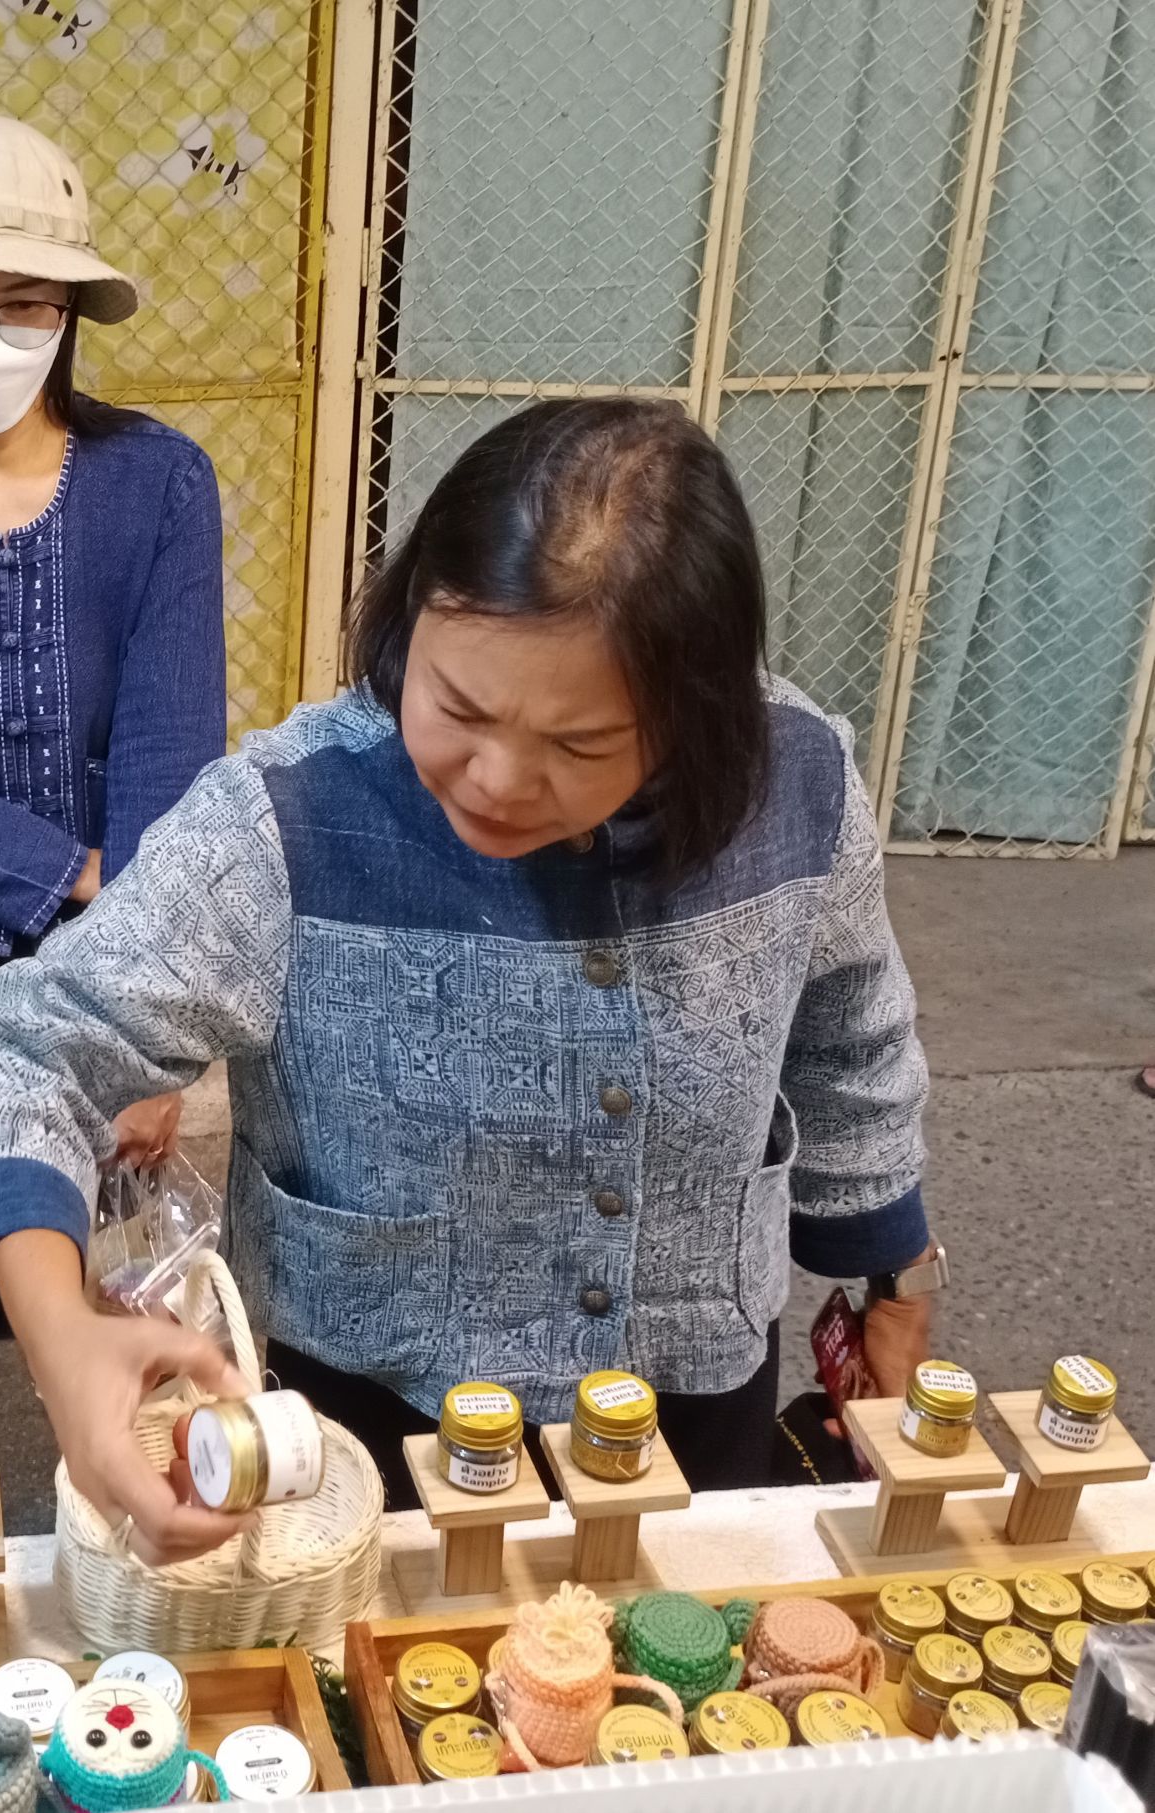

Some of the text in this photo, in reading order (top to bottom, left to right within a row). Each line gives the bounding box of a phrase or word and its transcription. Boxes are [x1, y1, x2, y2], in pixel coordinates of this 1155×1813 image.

[923, 1379, 973, 1390] Sample
[1050, 1416, 1098, 1436] ตัวอย่าง
[1049, 1425, 1095, 1445] Sample
[461, 1464, 509, 1477] ตัวอย่าง
[461, 1475, 507, 1487] Sample
